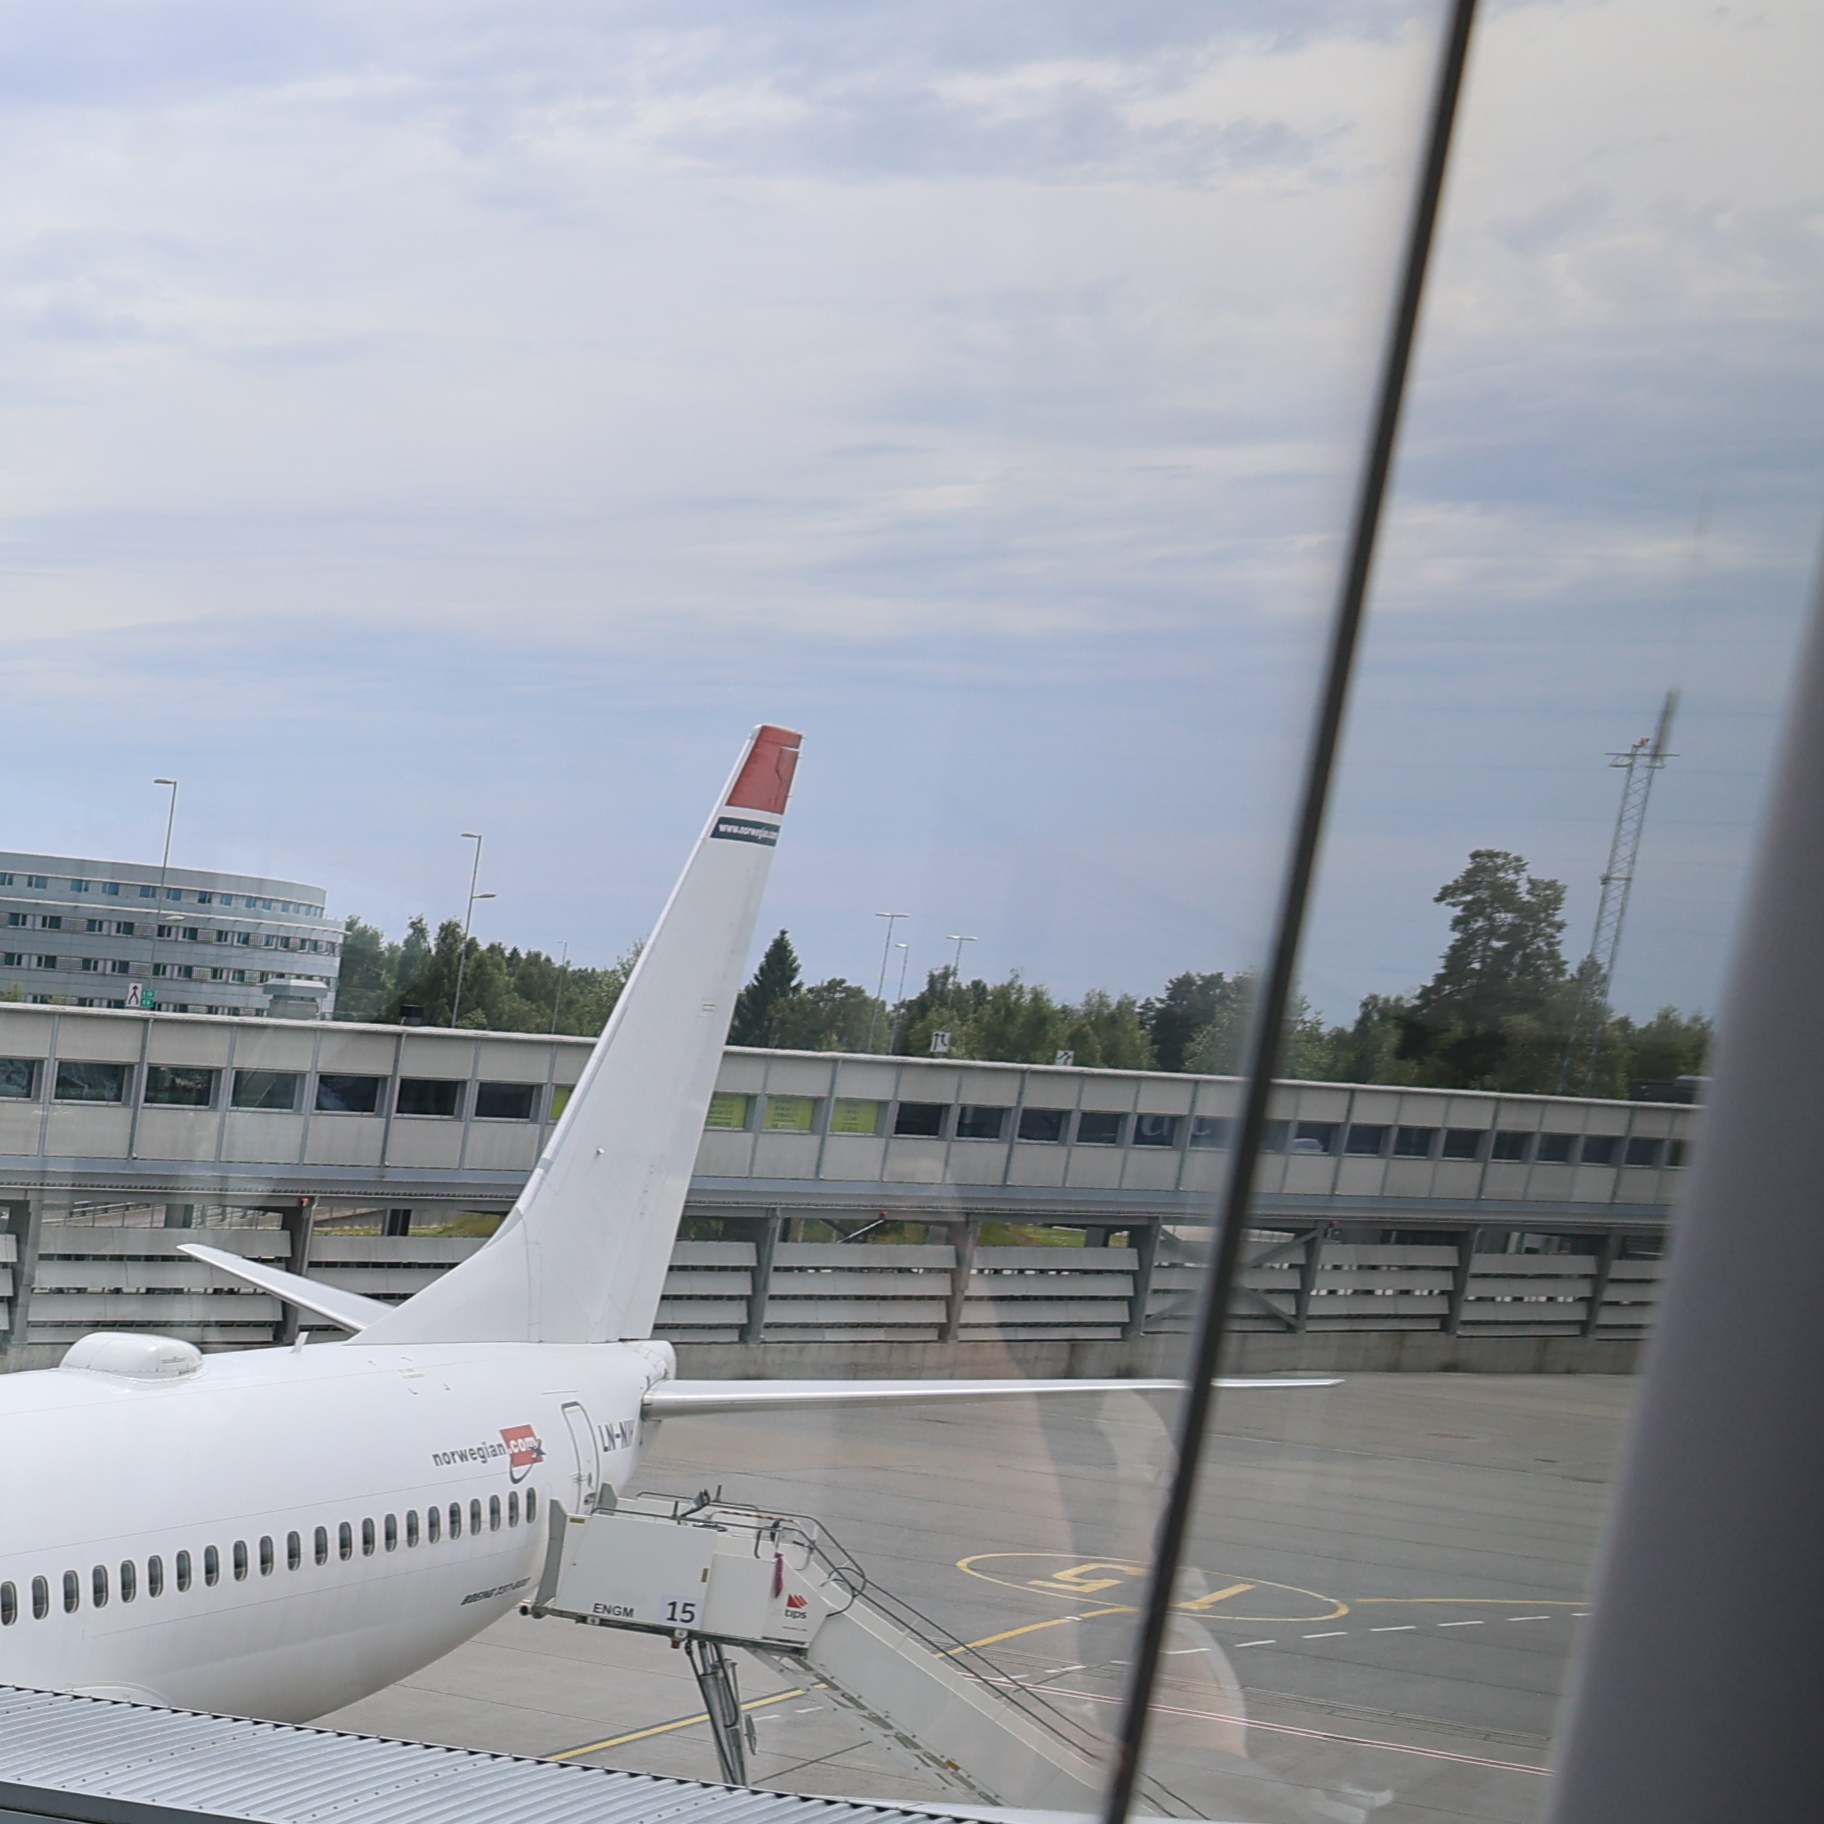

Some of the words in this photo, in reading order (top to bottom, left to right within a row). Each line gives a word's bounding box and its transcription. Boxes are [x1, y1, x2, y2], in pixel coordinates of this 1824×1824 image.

[433, 1437, 541, 1467] norwegian.com
[593, 1603, 634, 1618] ENGM
[666, 1600, 696, 1624] 15
